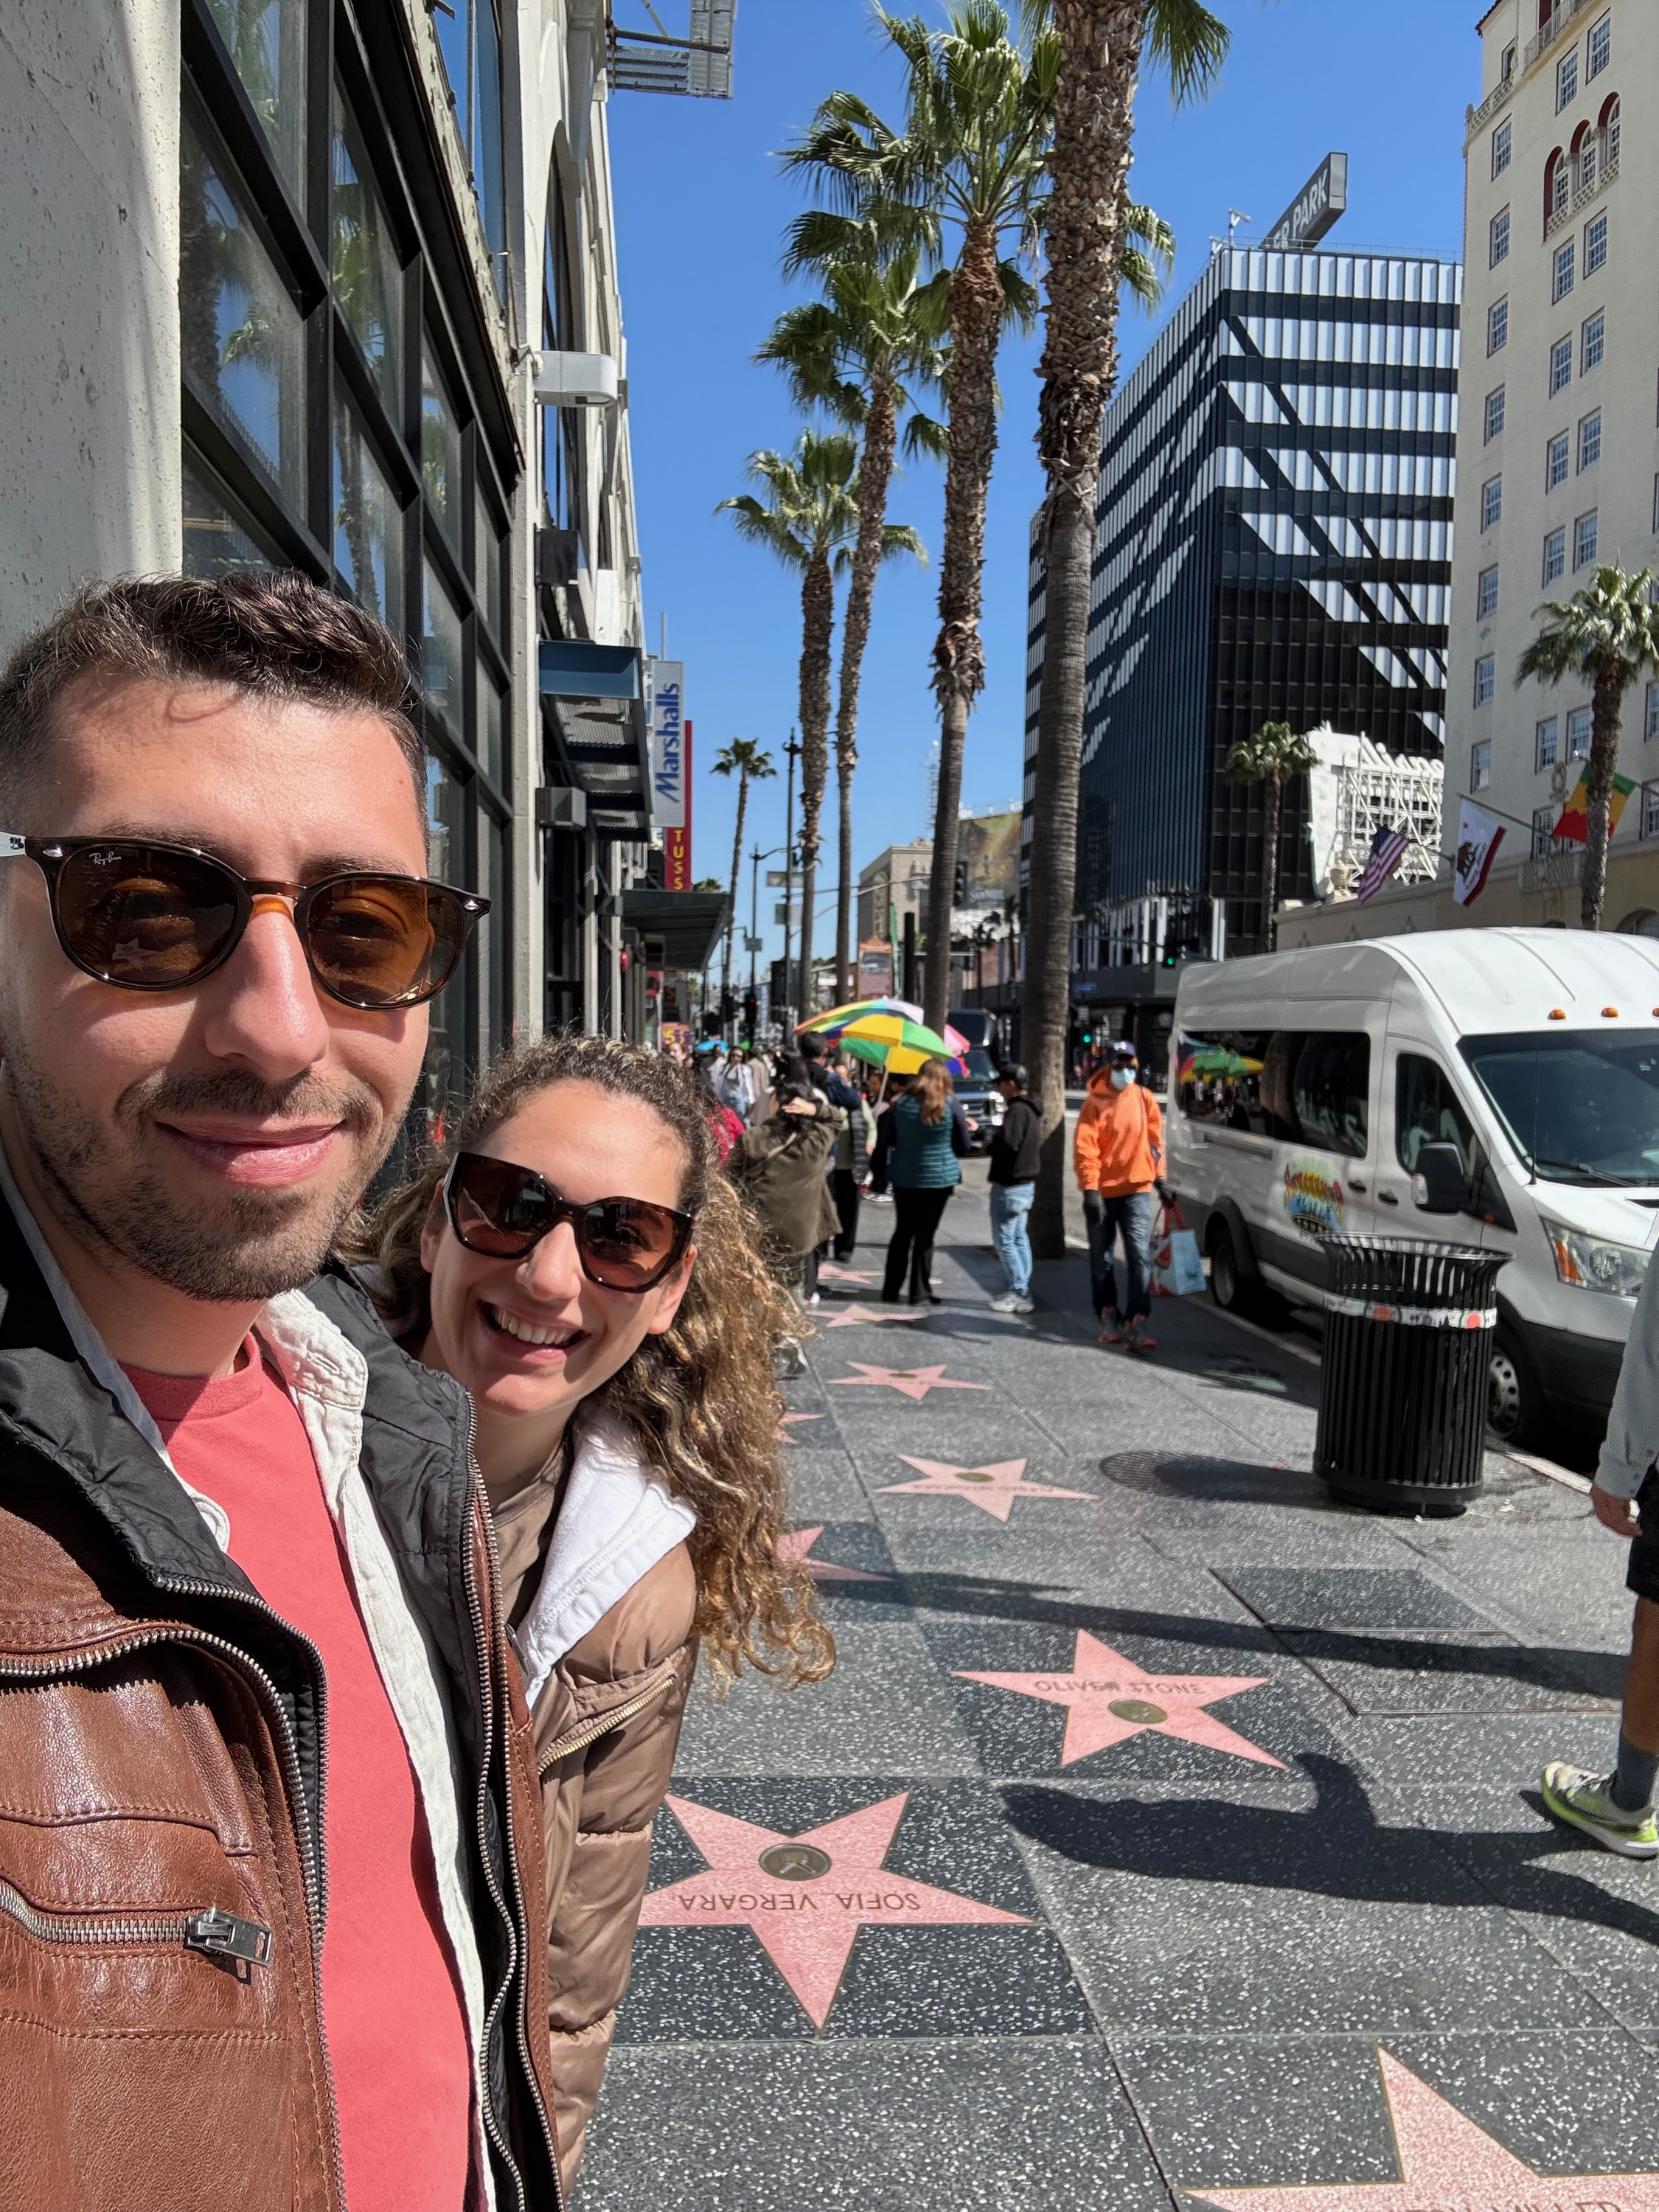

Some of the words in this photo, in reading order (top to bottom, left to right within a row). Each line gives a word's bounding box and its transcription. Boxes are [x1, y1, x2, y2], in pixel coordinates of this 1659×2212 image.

[1293, 167, 1328, 241] PARK
[655, 683, 680, 803] Marshalls
[1034, 1680, 1121, 1693] OLIVER
[1128, 1681, 1206, 1694] STONE
[678, 1893, 818, 1911] VERGARA
[835, 1893, 921, 1910] SOFIA
